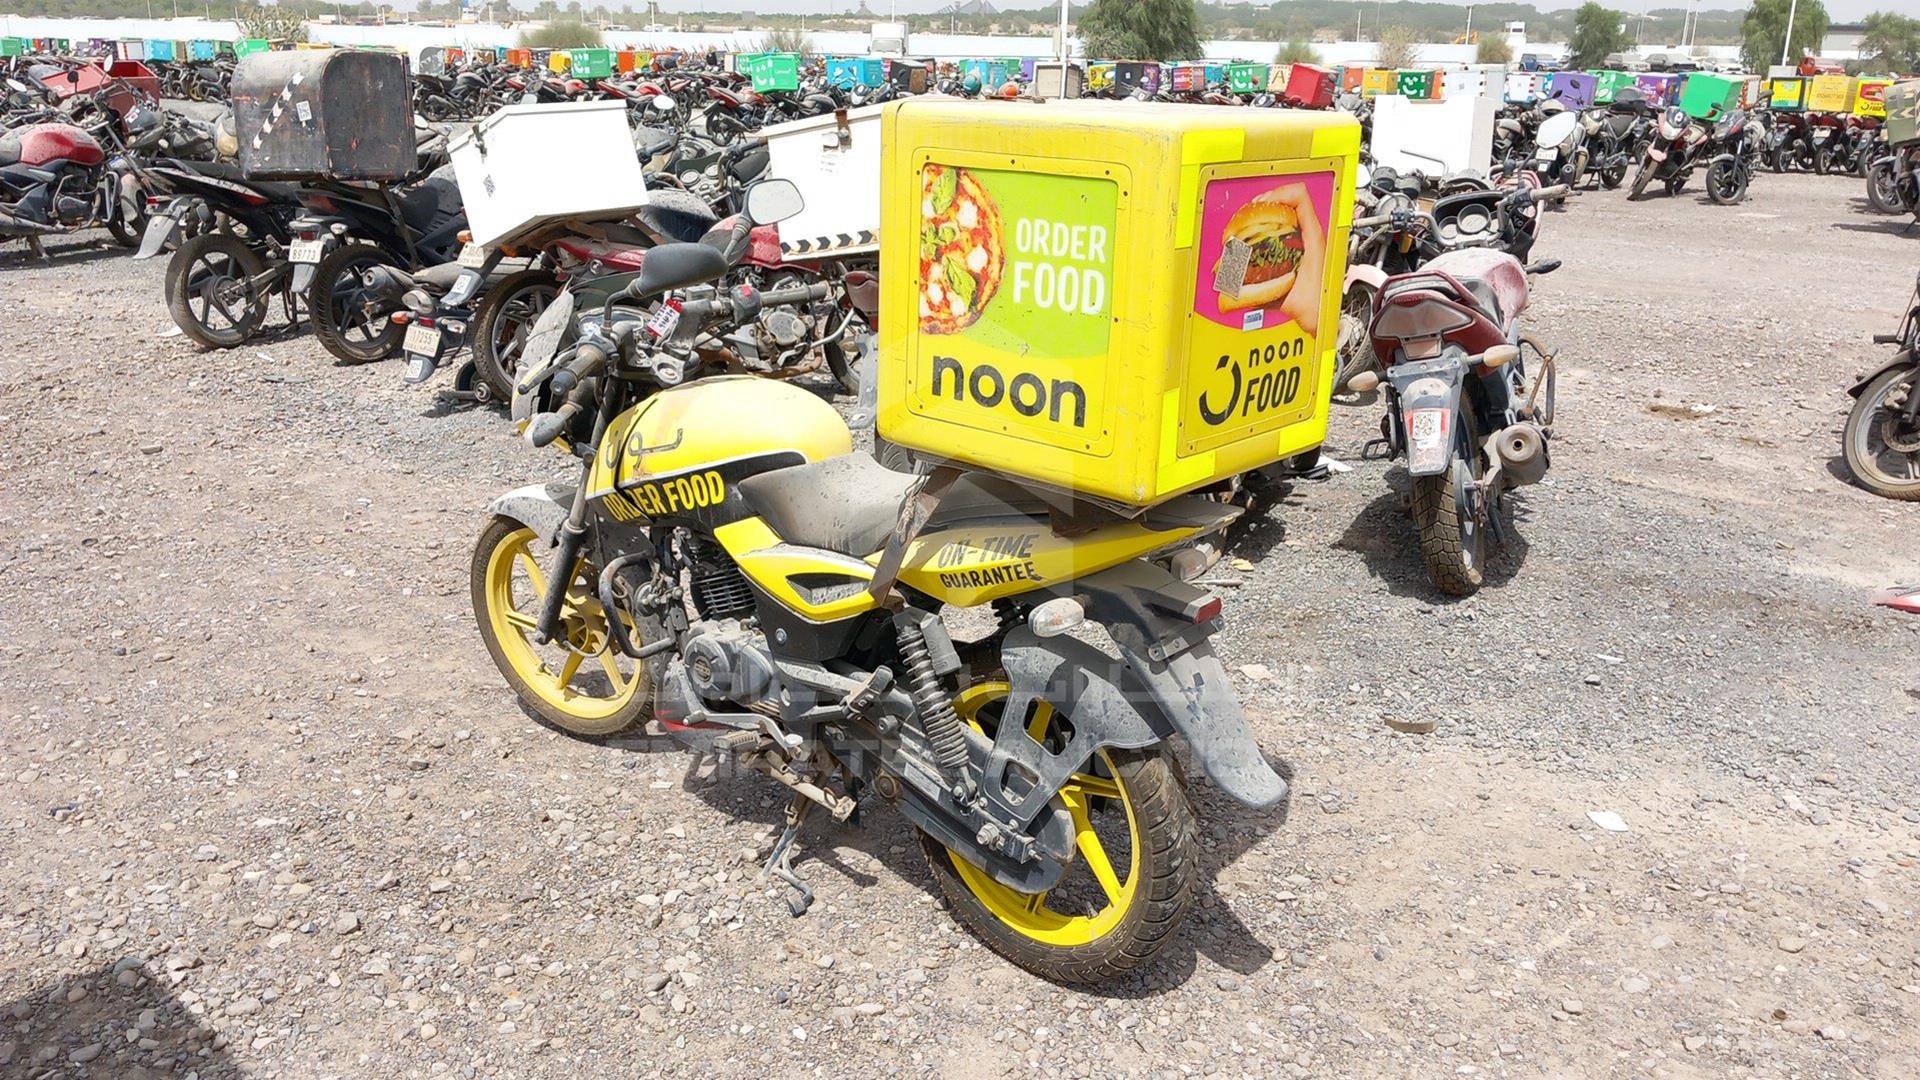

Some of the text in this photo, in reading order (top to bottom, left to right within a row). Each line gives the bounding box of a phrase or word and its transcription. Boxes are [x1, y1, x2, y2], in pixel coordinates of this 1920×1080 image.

[1015, 217, 1107, 264] ORDER
[1012, 261, 1105, 315] FOOD
[1249, 337, 1304, 368] noon
[931, 354, 1087, 428] noon
[1242, 366, 1301, 417] FOOD
[602, 470, 725, 522] ORDER FOOD
[937, 533, 1040, 568] ON-TIME
[939, 561, 1044, 588] GUARANTEE
